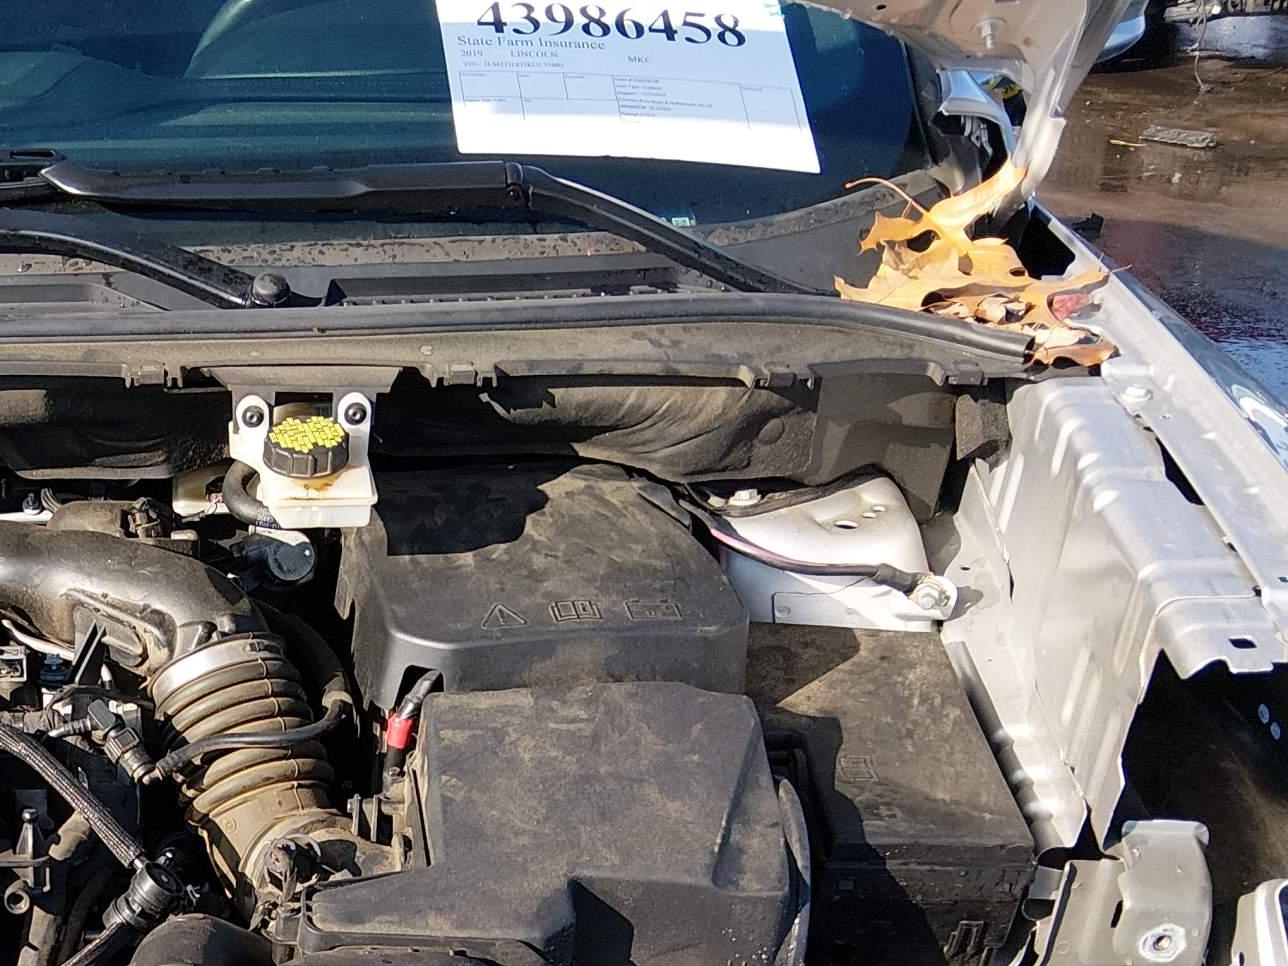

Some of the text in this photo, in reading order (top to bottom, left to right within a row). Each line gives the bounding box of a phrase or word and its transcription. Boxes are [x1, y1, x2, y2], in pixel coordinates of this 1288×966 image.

[476, 1, 746, 47] 43986458
[457, 35, 606, 50] State Farm Insurance
[510, 50, 559, 58] LINCOLN
